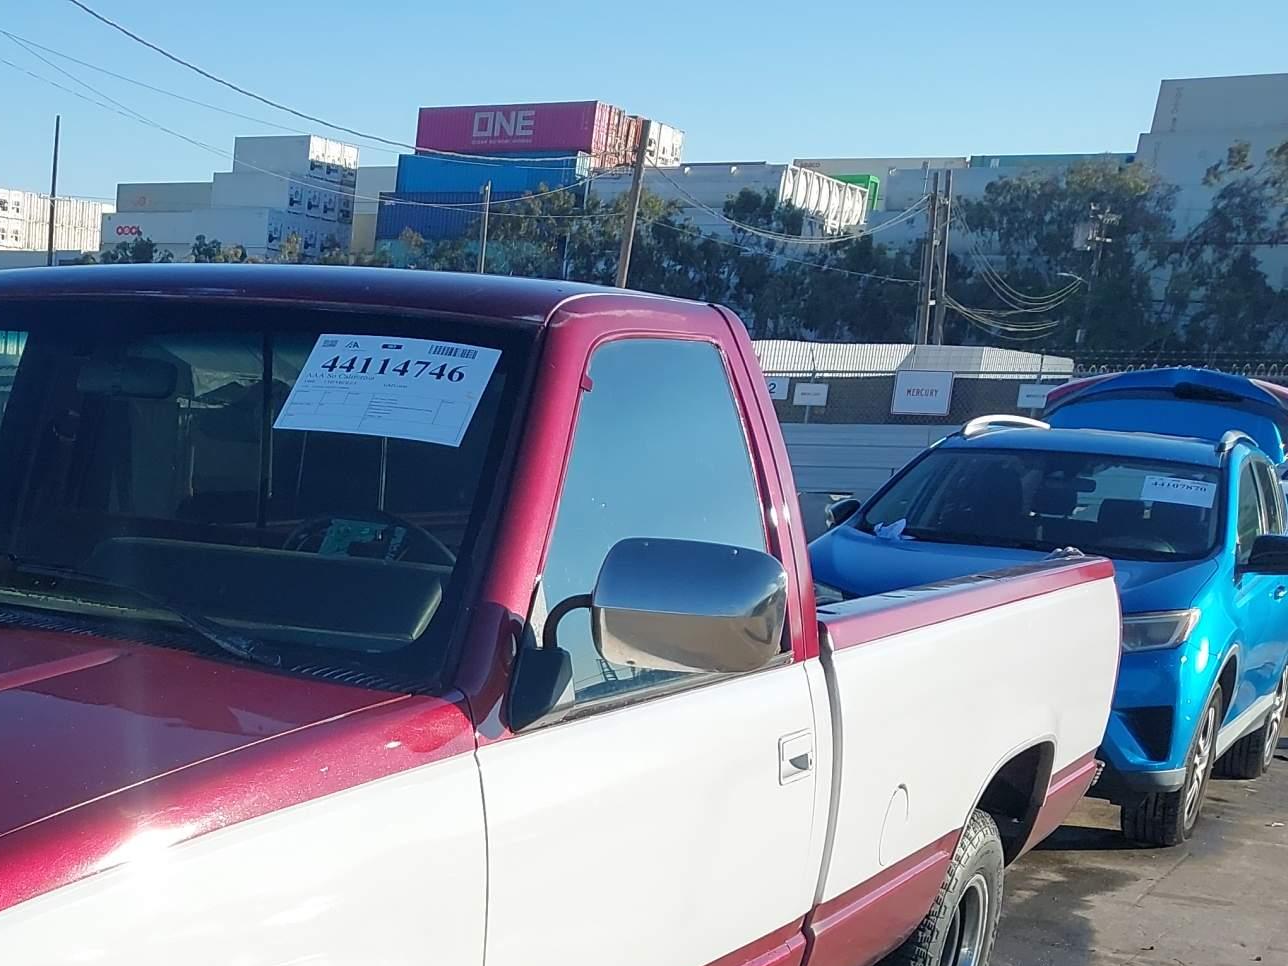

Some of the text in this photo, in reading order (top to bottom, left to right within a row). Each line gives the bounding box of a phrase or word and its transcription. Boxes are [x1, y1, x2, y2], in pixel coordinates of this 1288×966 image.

[472, 111, 536, 137] ONE
[321, 355, 469, 383] 44114746
[768, 382, 777, 394] 2
[906, 388, 939, 398] MERCURY
